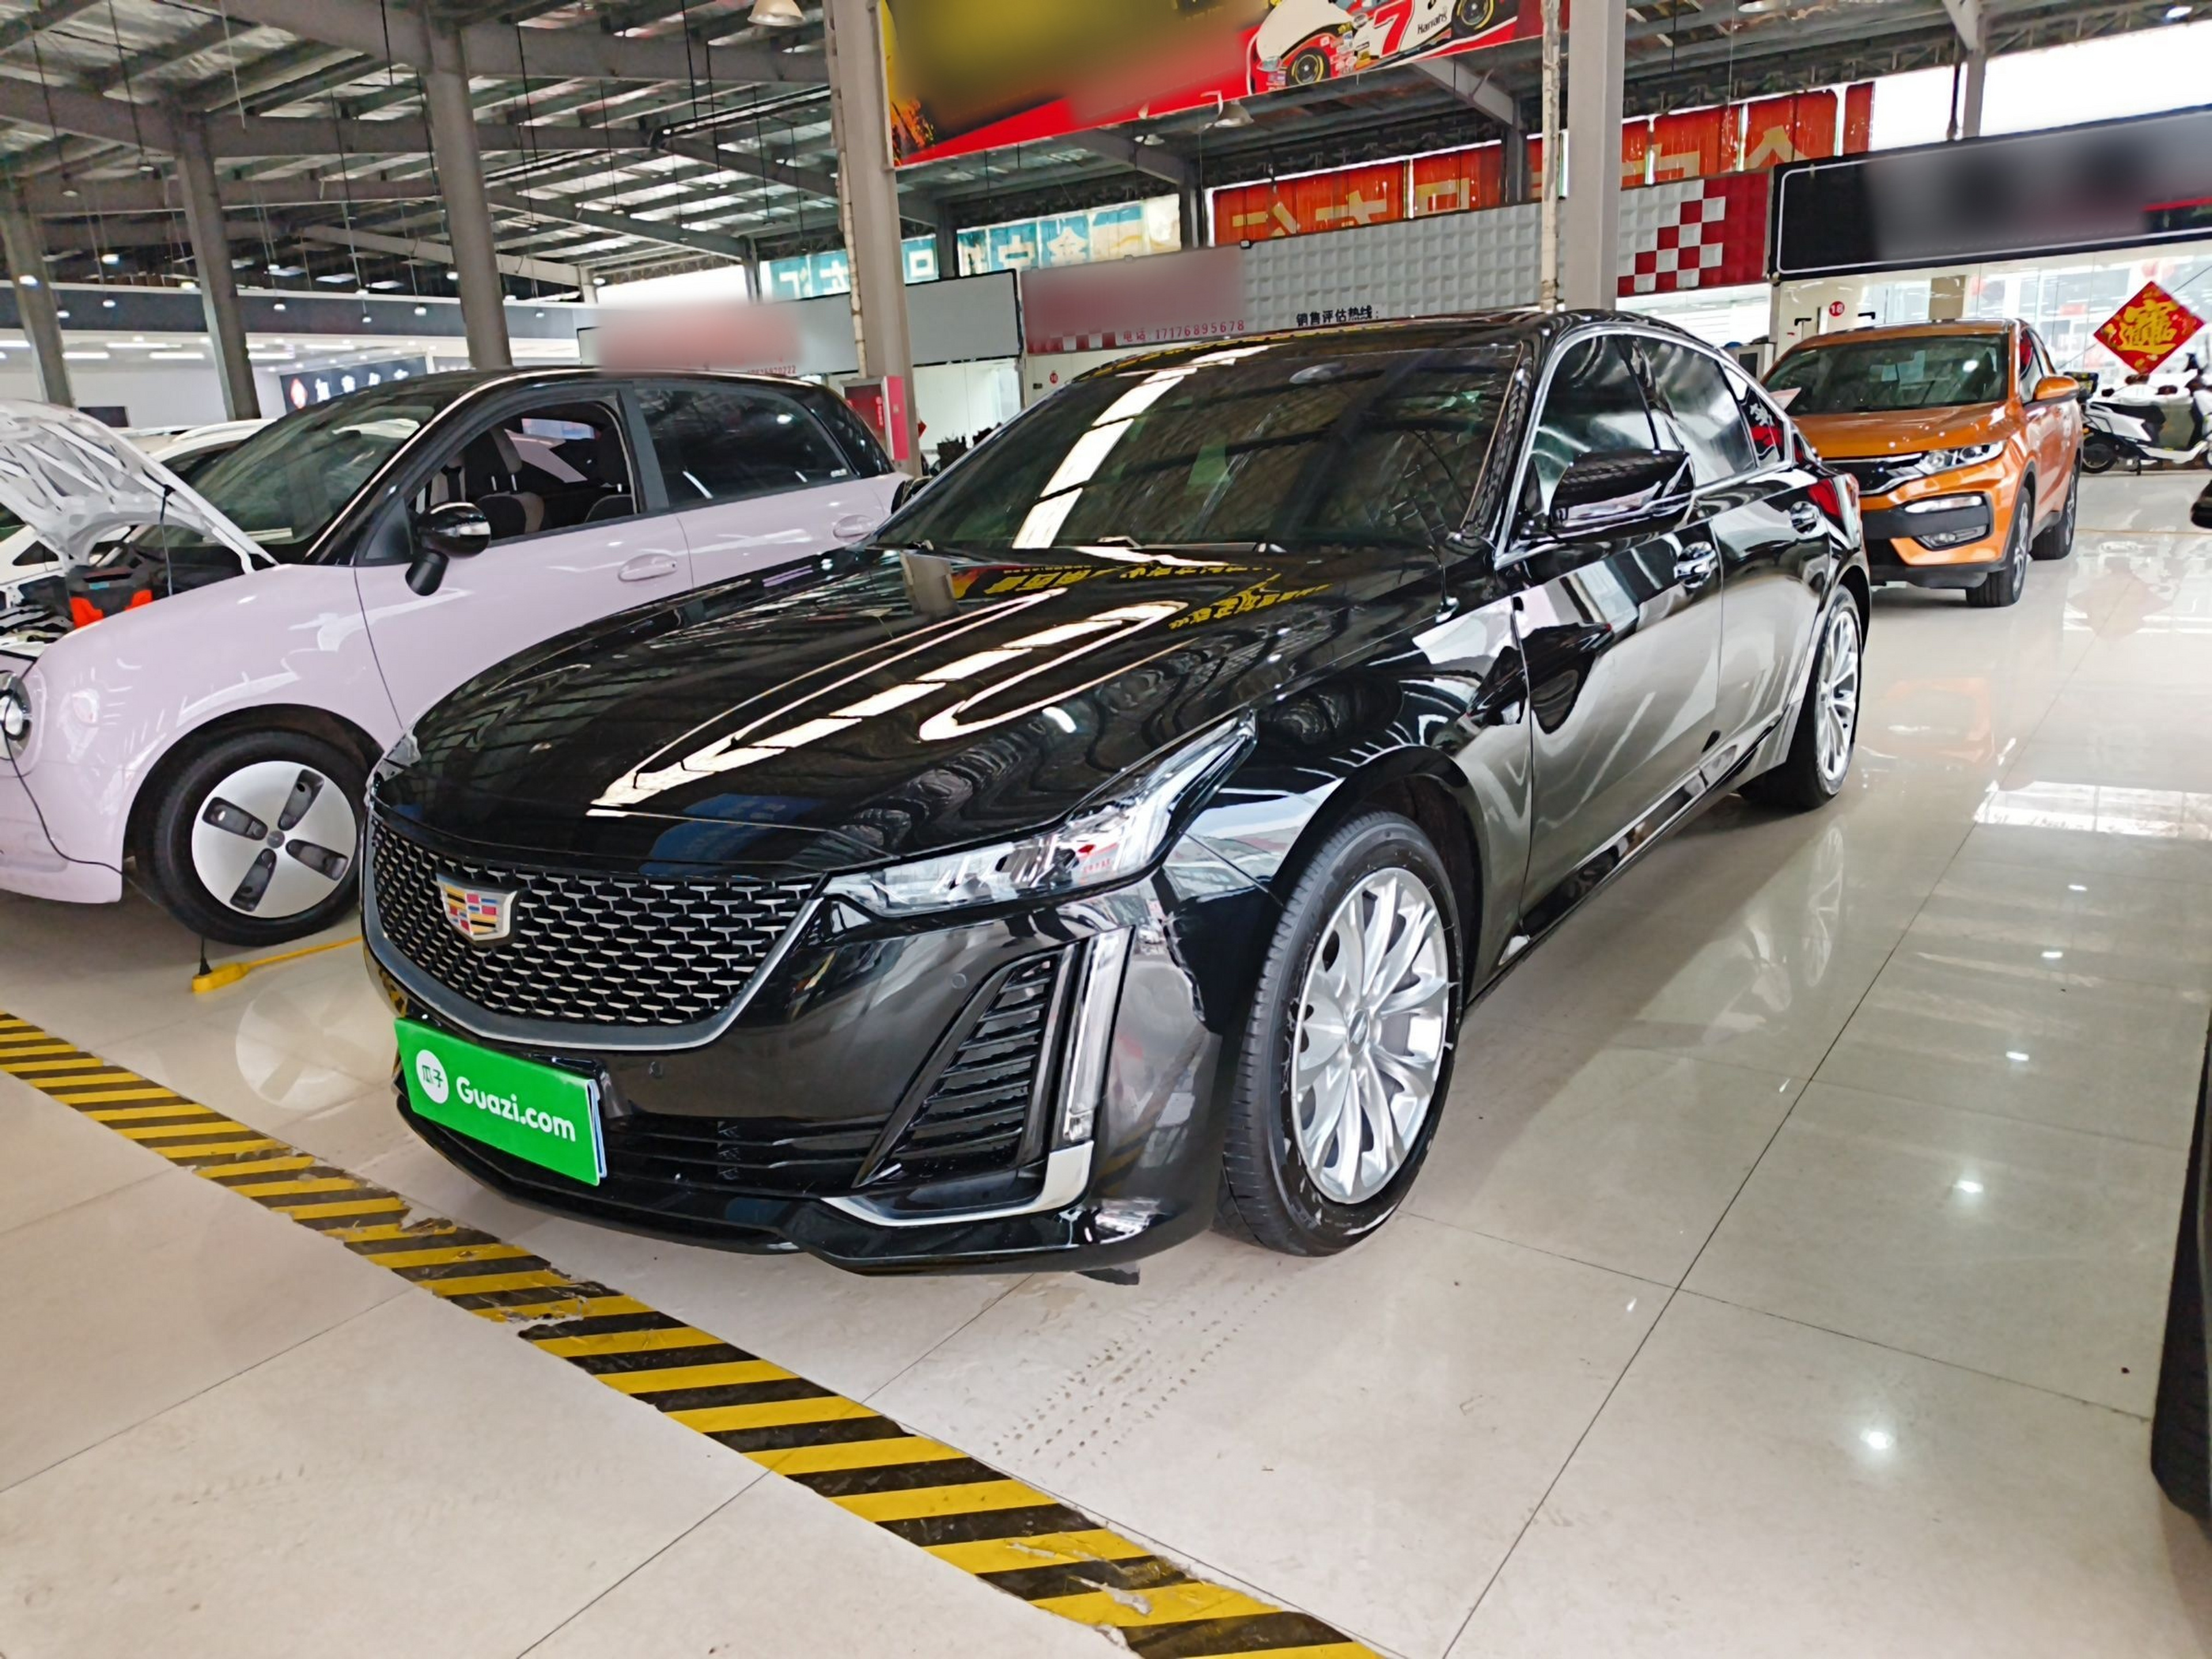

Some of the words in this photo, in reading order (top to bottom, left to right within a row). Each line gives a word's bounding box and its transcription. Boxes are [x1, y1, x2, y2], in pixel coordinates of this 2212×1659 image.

[1374, 0, 1415, 58] 7
[1831, 304, 1844, 314] 18
[422, 1065, 443, 1088] 瓜子
[456, 1076, 576, 1142] Guazi.com
